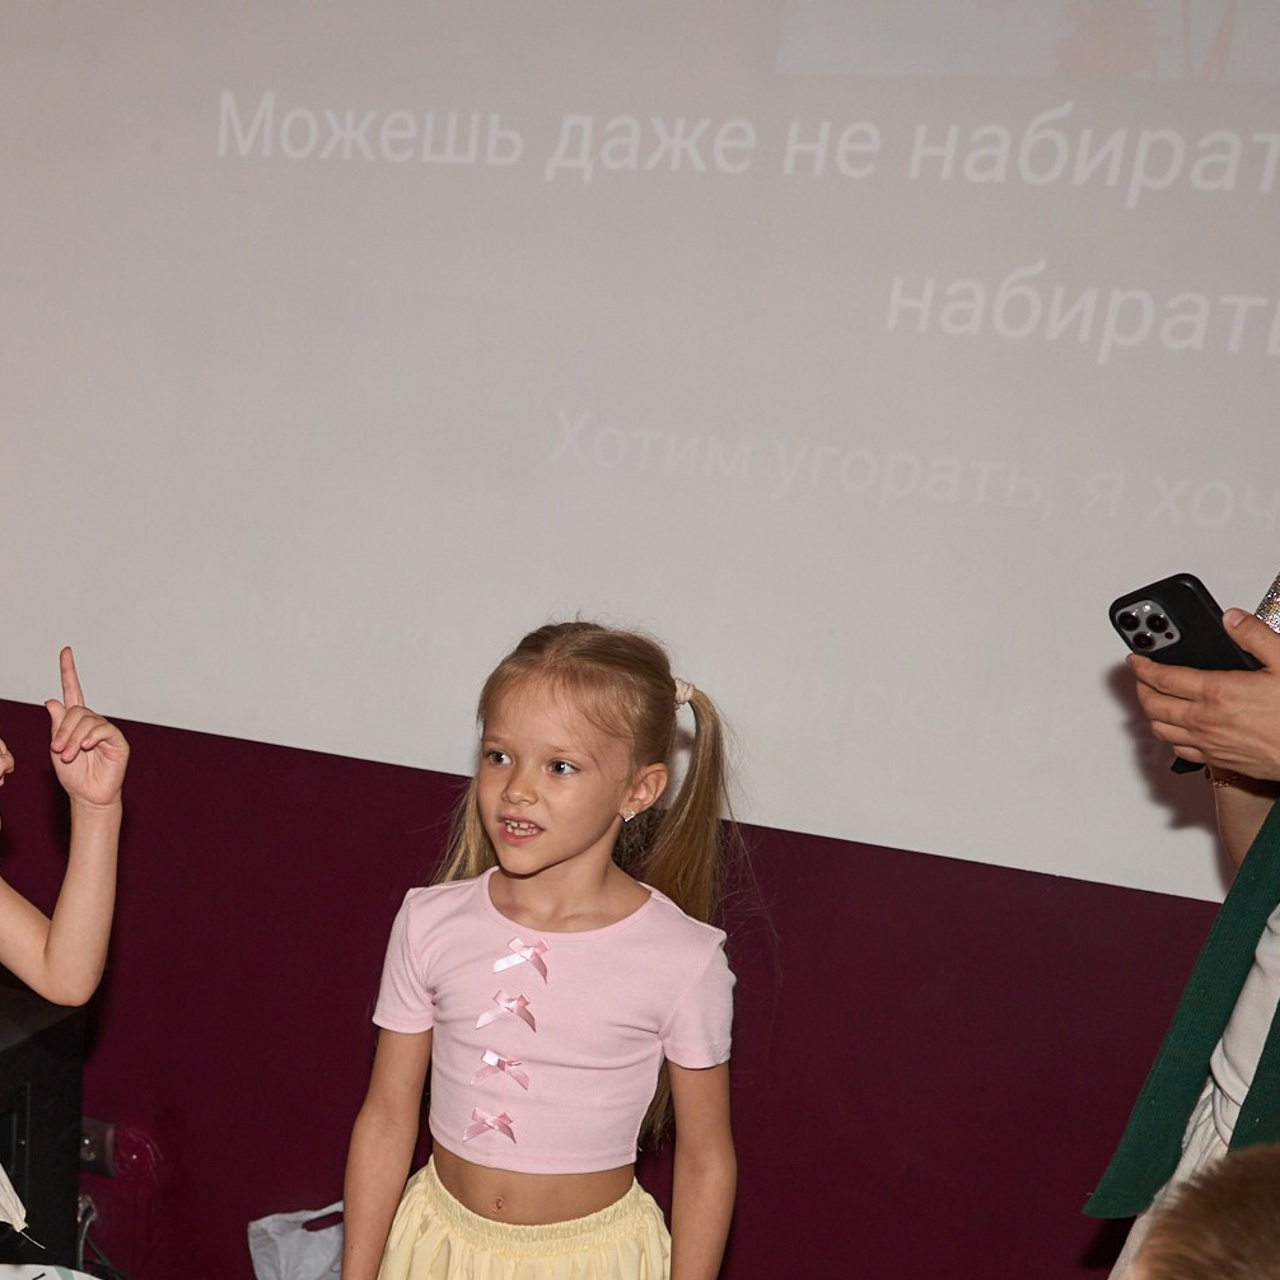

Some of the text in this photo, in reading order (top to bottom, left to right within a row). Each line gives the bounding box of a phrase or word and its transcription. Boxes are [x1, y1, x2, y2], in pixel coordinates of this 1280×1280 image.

[217, 90, 523, 165] Можешь
[545, 115, 756, 183] даже
[783, 121, 881, 179] не
[548, 407, 753, 481] Хотим
[770, 438, 1057, 523] угорать,
[1081, 469, 1125, 516] я
